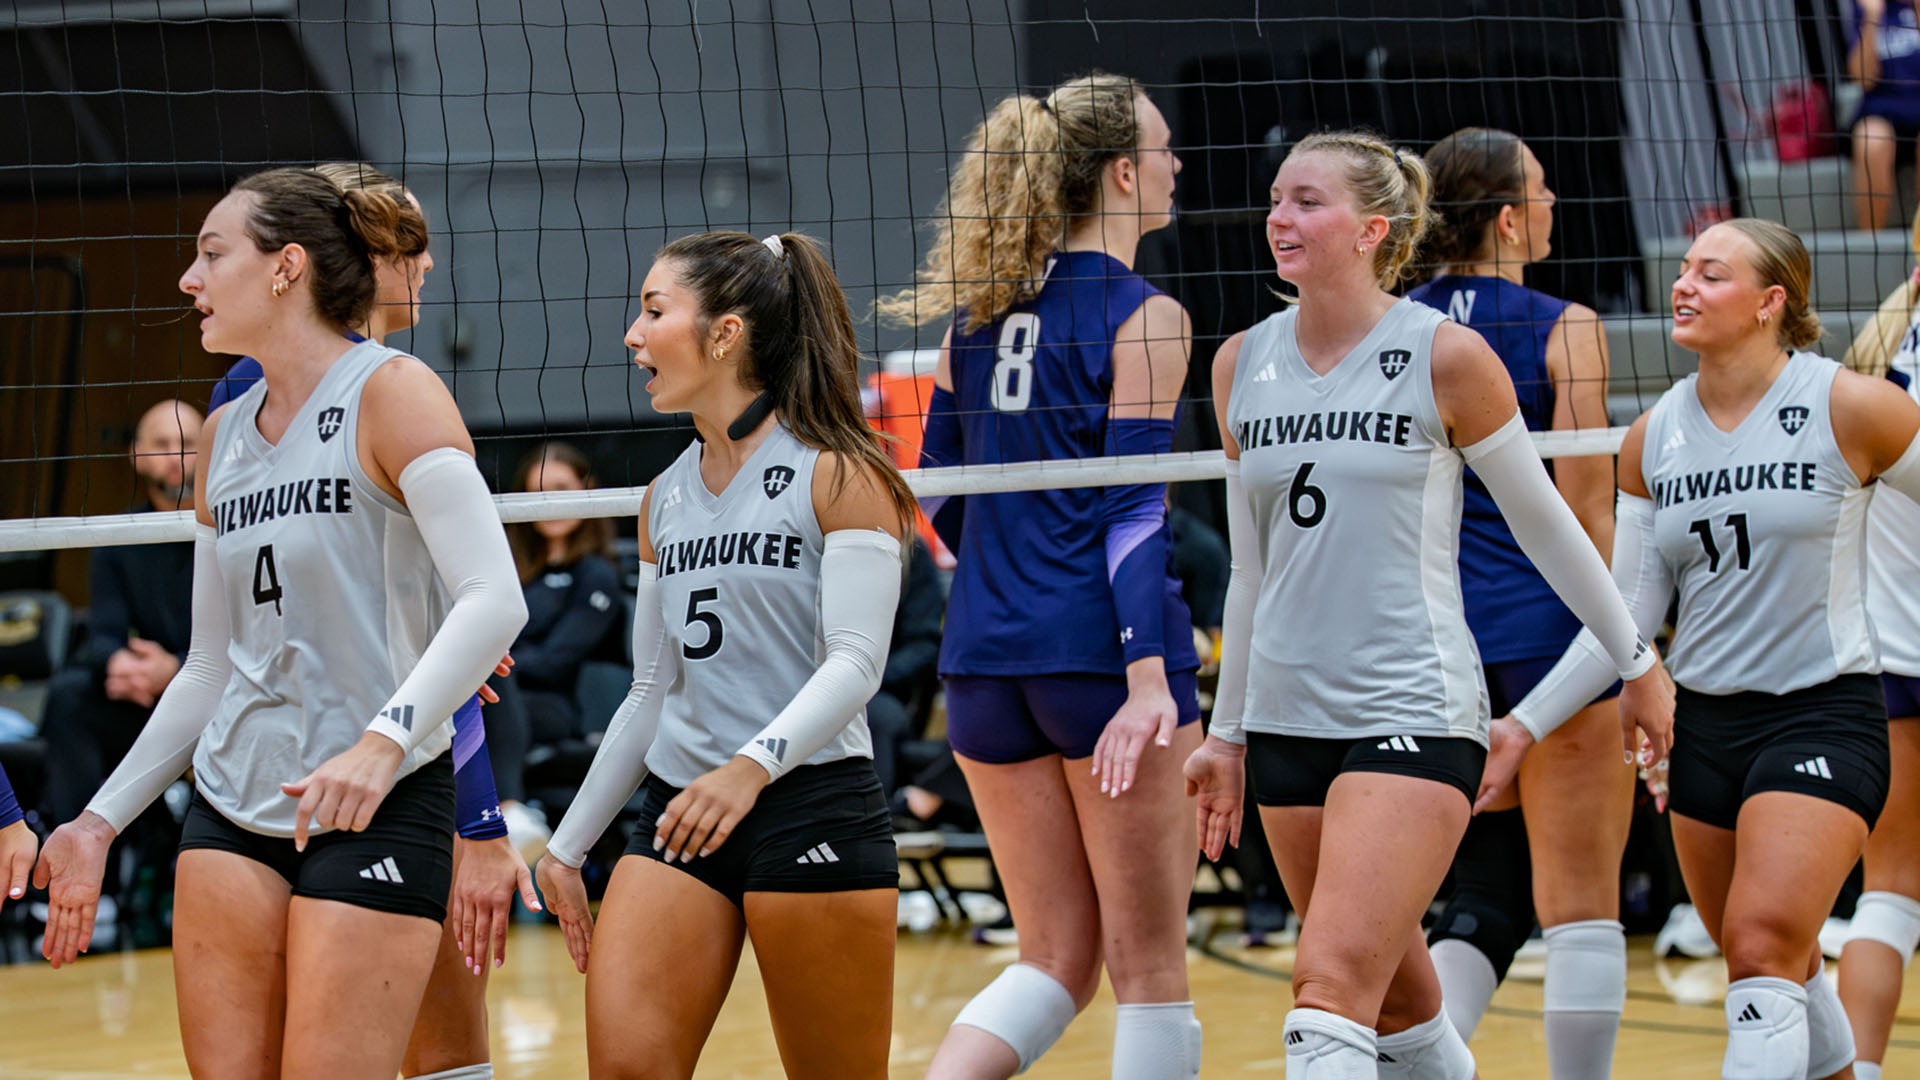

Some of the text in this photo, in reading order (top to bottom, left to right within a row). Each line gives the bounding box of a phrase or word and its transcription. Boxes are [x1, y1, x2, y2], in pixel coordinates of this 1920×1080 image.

[990, 313, 1040, 412] 8
[1237, 411, 1413, 453] MILWAUKEE
[1289, 462, 1327, 528] 6
[656, 531, 803, 581] ILWAUKEE
[1689, 513, 1751, 573] 11
[252, 544, 282, 616] 4
[683, 587, 723, 660] 5
